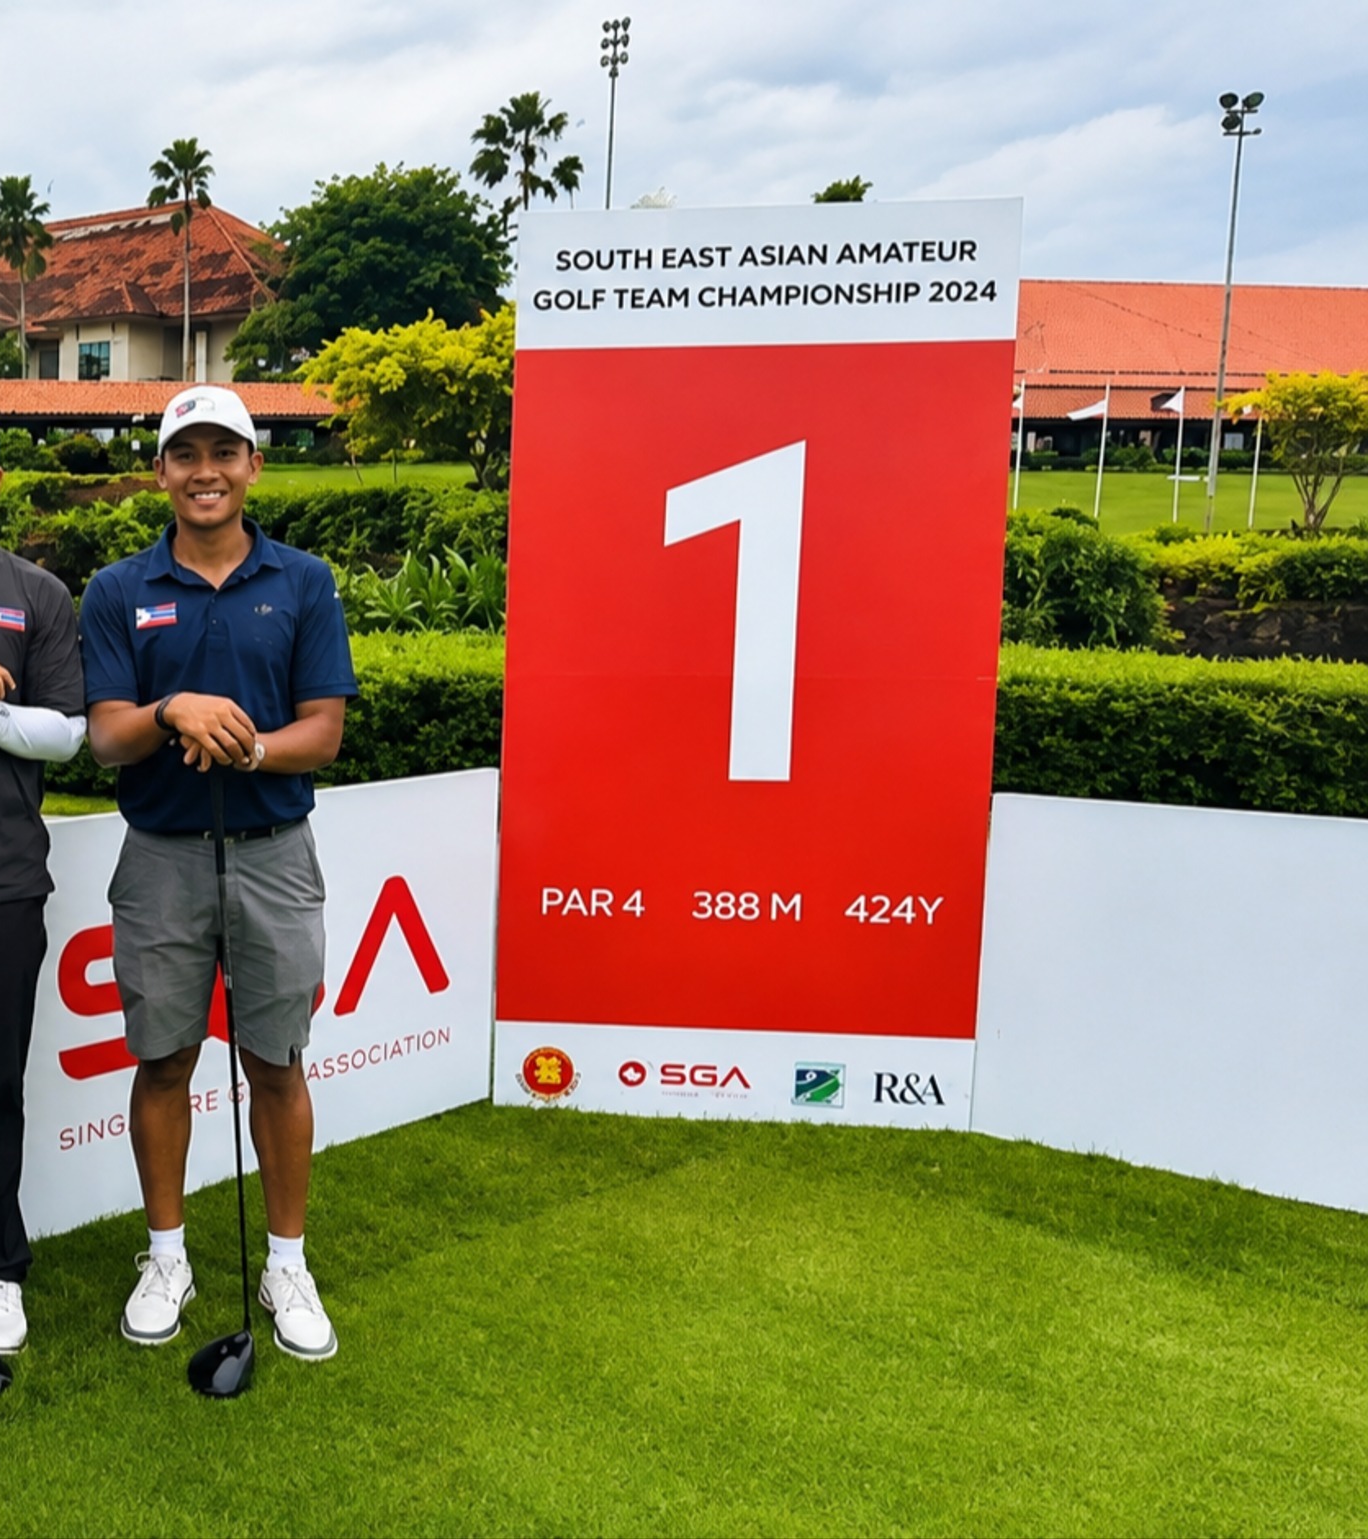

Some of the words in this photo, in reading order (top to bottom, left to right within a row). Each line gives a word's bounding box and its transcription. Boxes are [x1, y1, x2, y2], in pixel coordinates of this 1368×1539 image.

[555, 247, 653, 272] SOUTH
[661, 246, 732, 270] EAST
[738, 244, 829, 268] ASIAN
[835, 240, 978, 265] AMATEUR
[533, 289, 607, 311] GOLF
[612, 287, 691, 309] TEAM
[697, 282, 921, 308] CHAMPIONSHIP
[927, 280, 998, 303] 2024
[663, 439, 807, 782] 1
[541, 887, 614, 917] PAR
[621, 889, 646, 918] 4
[691, 891, 761, 921] 388
[770, 892, 803, 922] M
[843, 894, 944, 925] 424Y
[59, 1088, 219, 1151] SINGRE
[307, 1026, 451, 1084] ASSOCIATION
[660, 1062, 751, 1090] SGA
[873, 1072, 946, 1106] R&A
